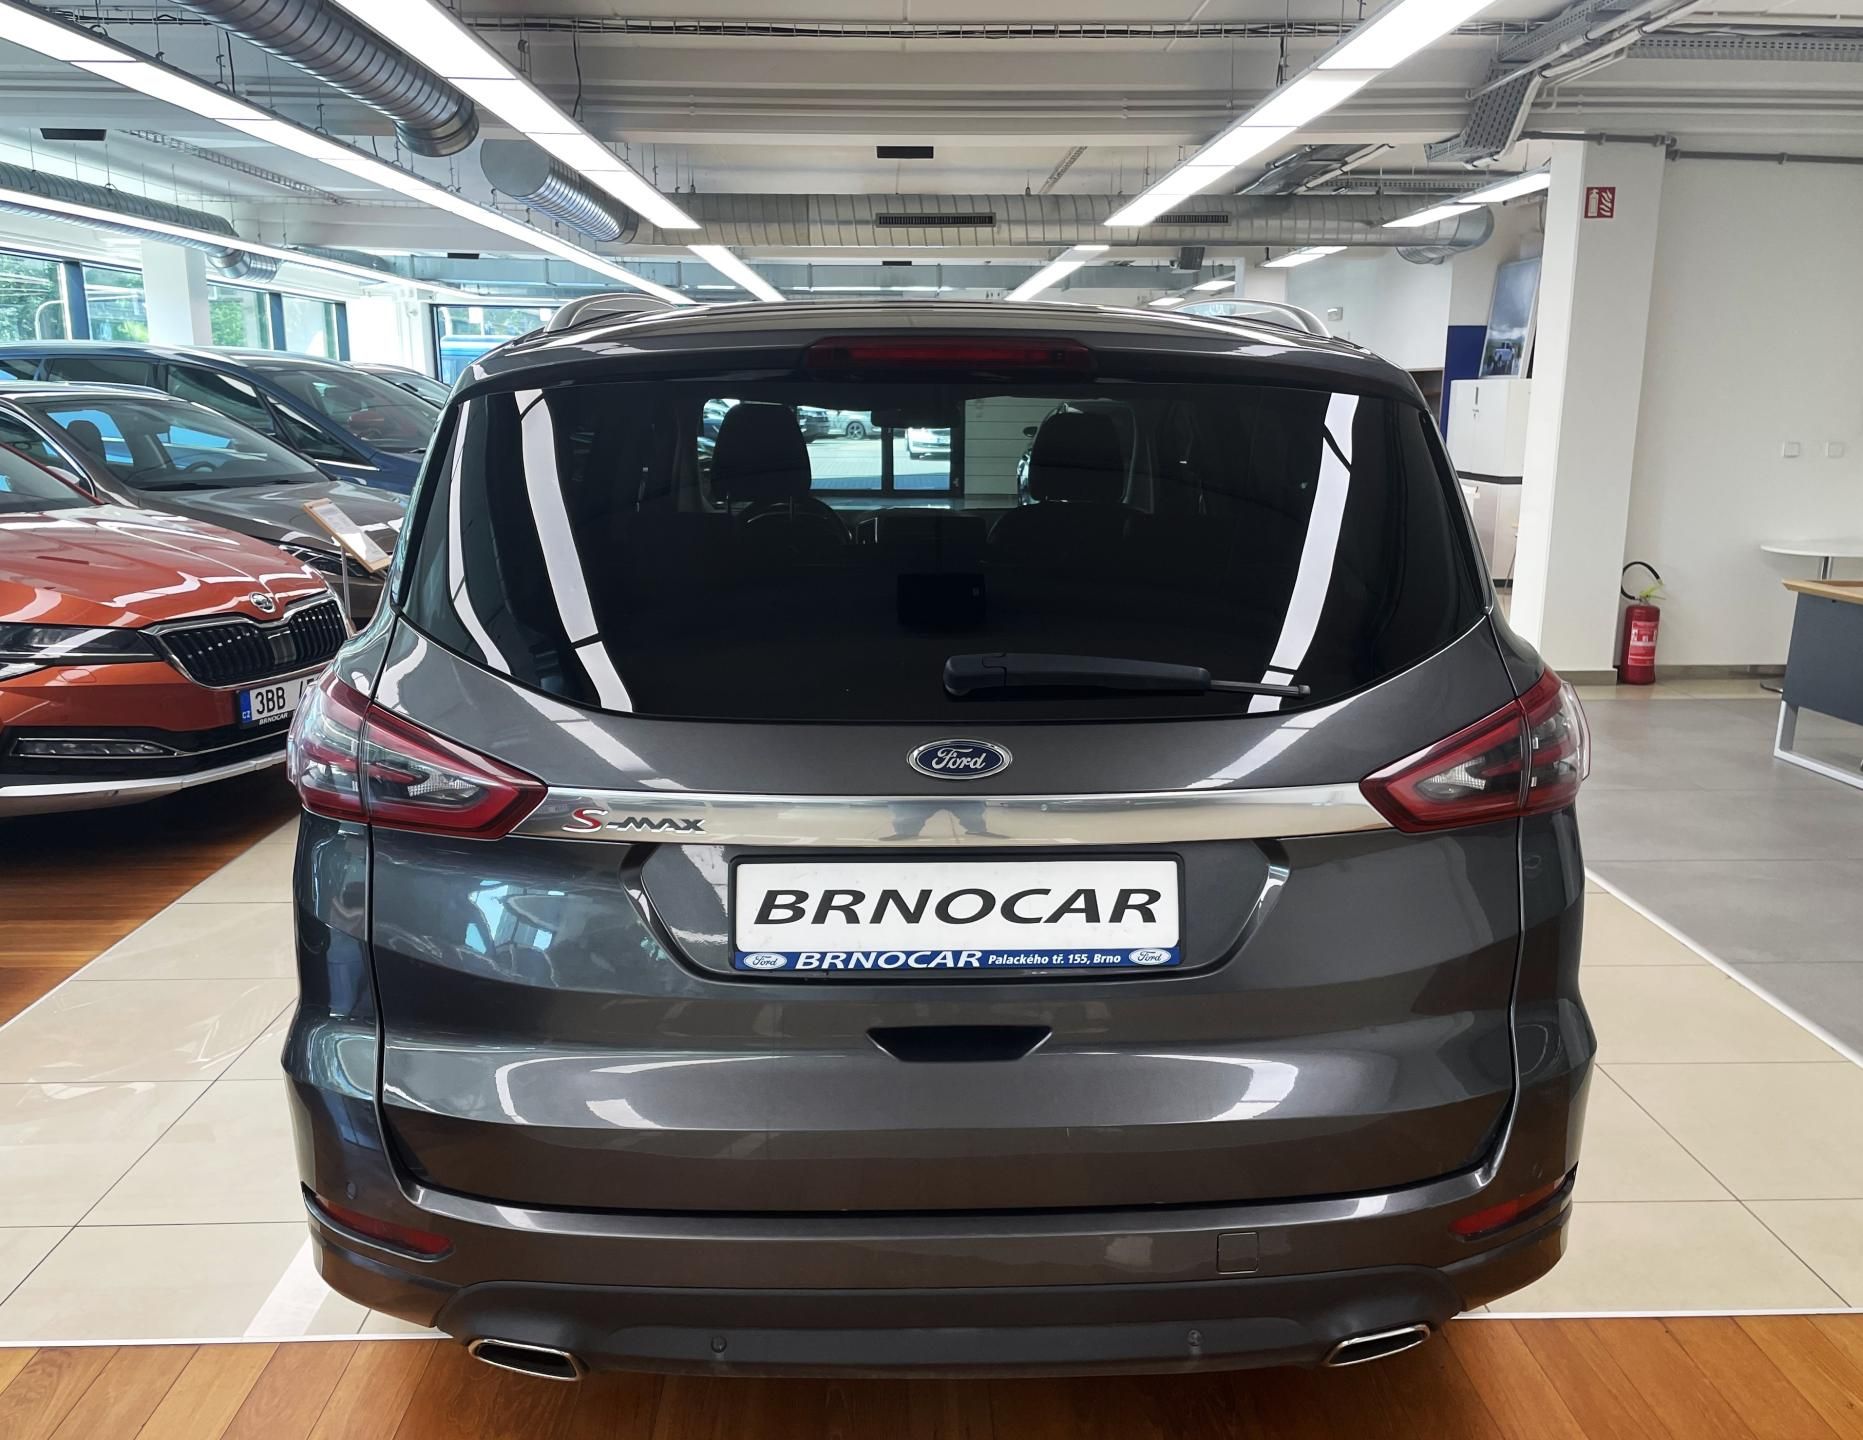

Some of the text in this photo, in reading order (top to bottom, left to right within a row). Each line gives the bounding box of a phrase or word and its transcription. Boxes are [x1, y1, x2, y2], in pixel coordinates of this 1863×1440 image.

[255, 686, 286, 715] 3BB
[242, 710, 251, 719] CZ
[259, 712, 289, 726] BRNOCAR
[931, 747, 987, 769] Ford
[562, 807, 707, 834] S-MAX
[753, 888, 1163, 925] BRNOCAR
[752, 954, 779, 967] Ford
[795, 950, 1122, 969] BRNOCAR Palackého tř. 155, Brno
[1137, 951, 1162, 962] Ford
